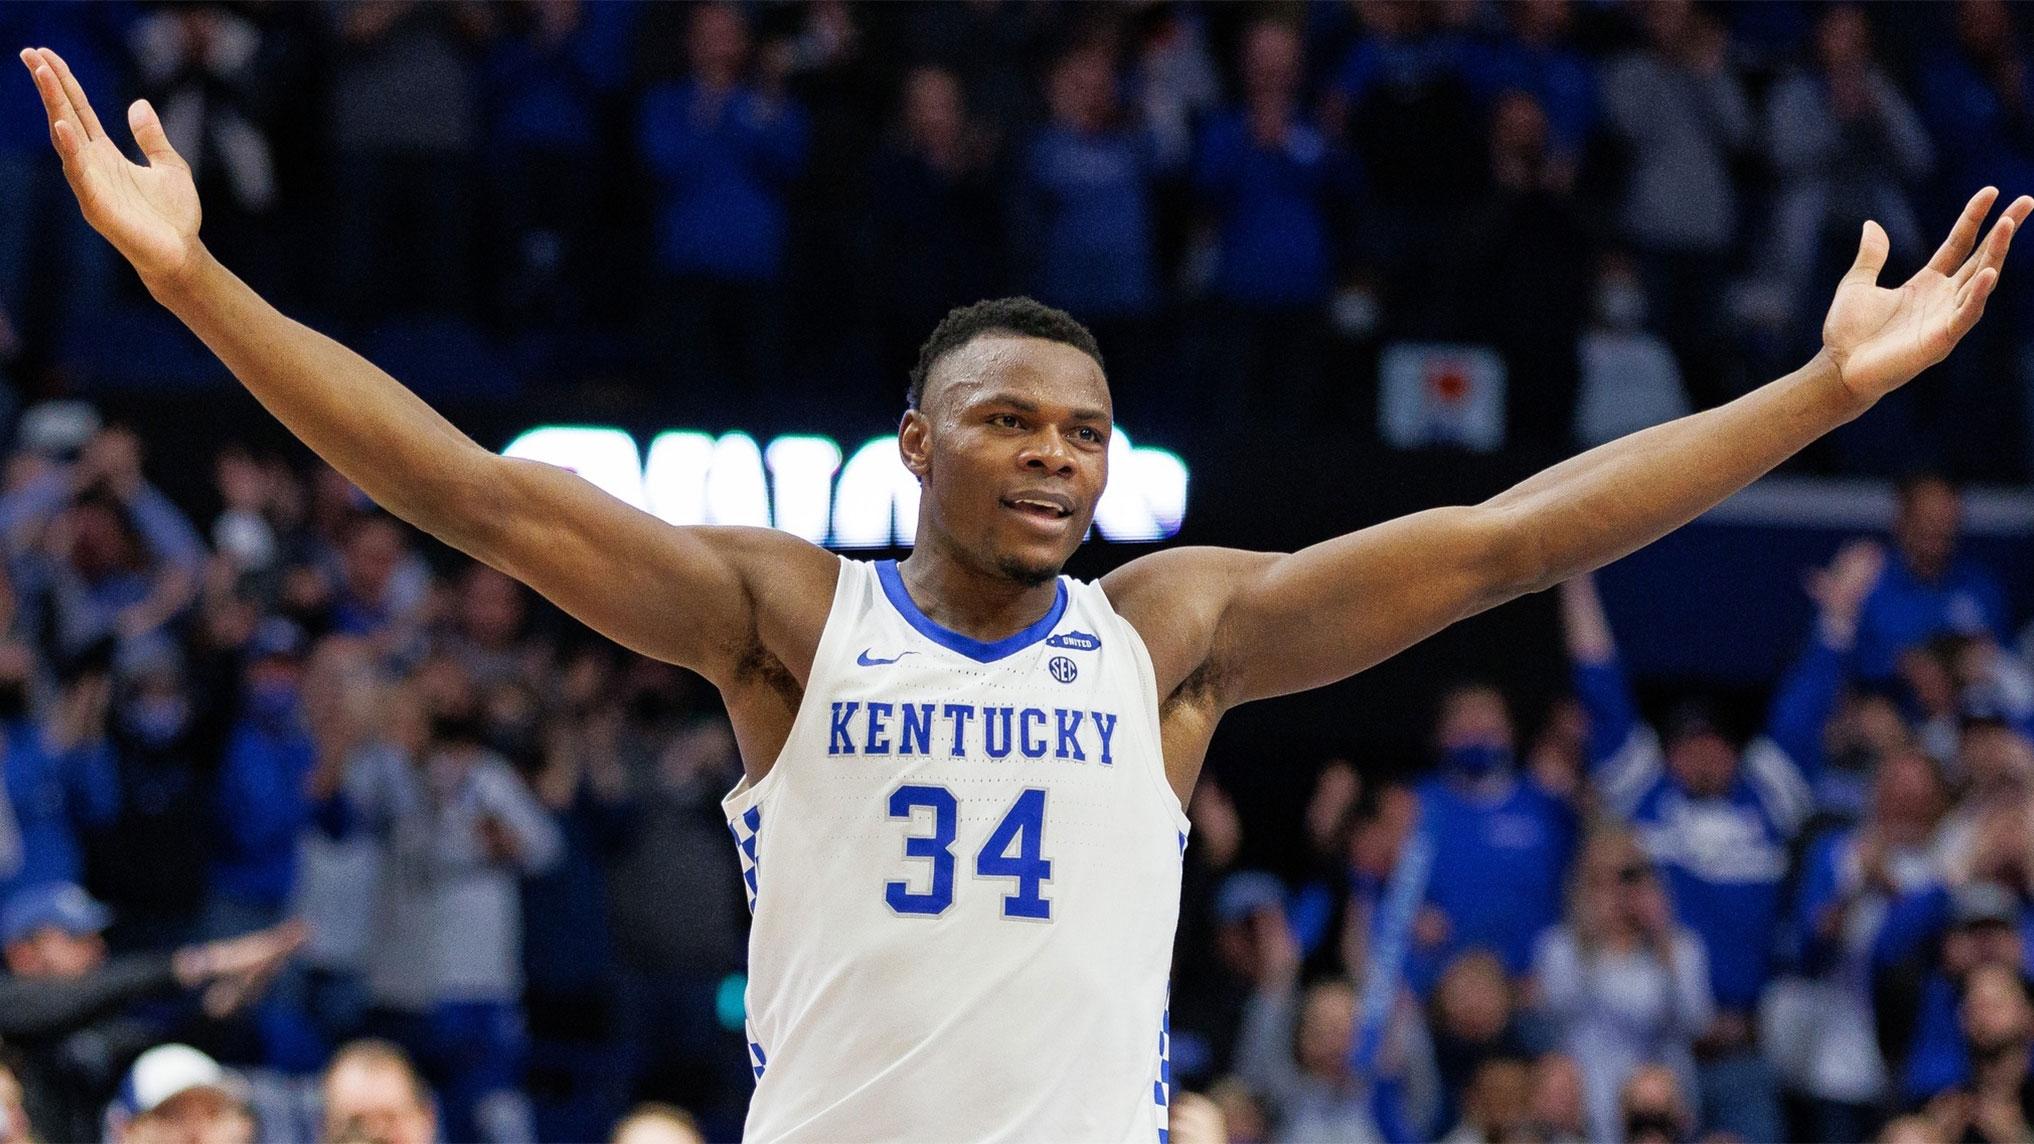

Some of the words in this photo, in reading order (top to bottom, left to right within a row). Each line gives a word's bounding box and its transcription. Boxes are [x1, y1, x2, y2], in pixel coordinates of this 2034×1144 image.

[1062, 636, 1093, 648] UNITED
[1050, 657, 1077, 682] SEC
[828, 701, 1118, 767] KENTUCKY
[883, 784, 1054, 923] 34
